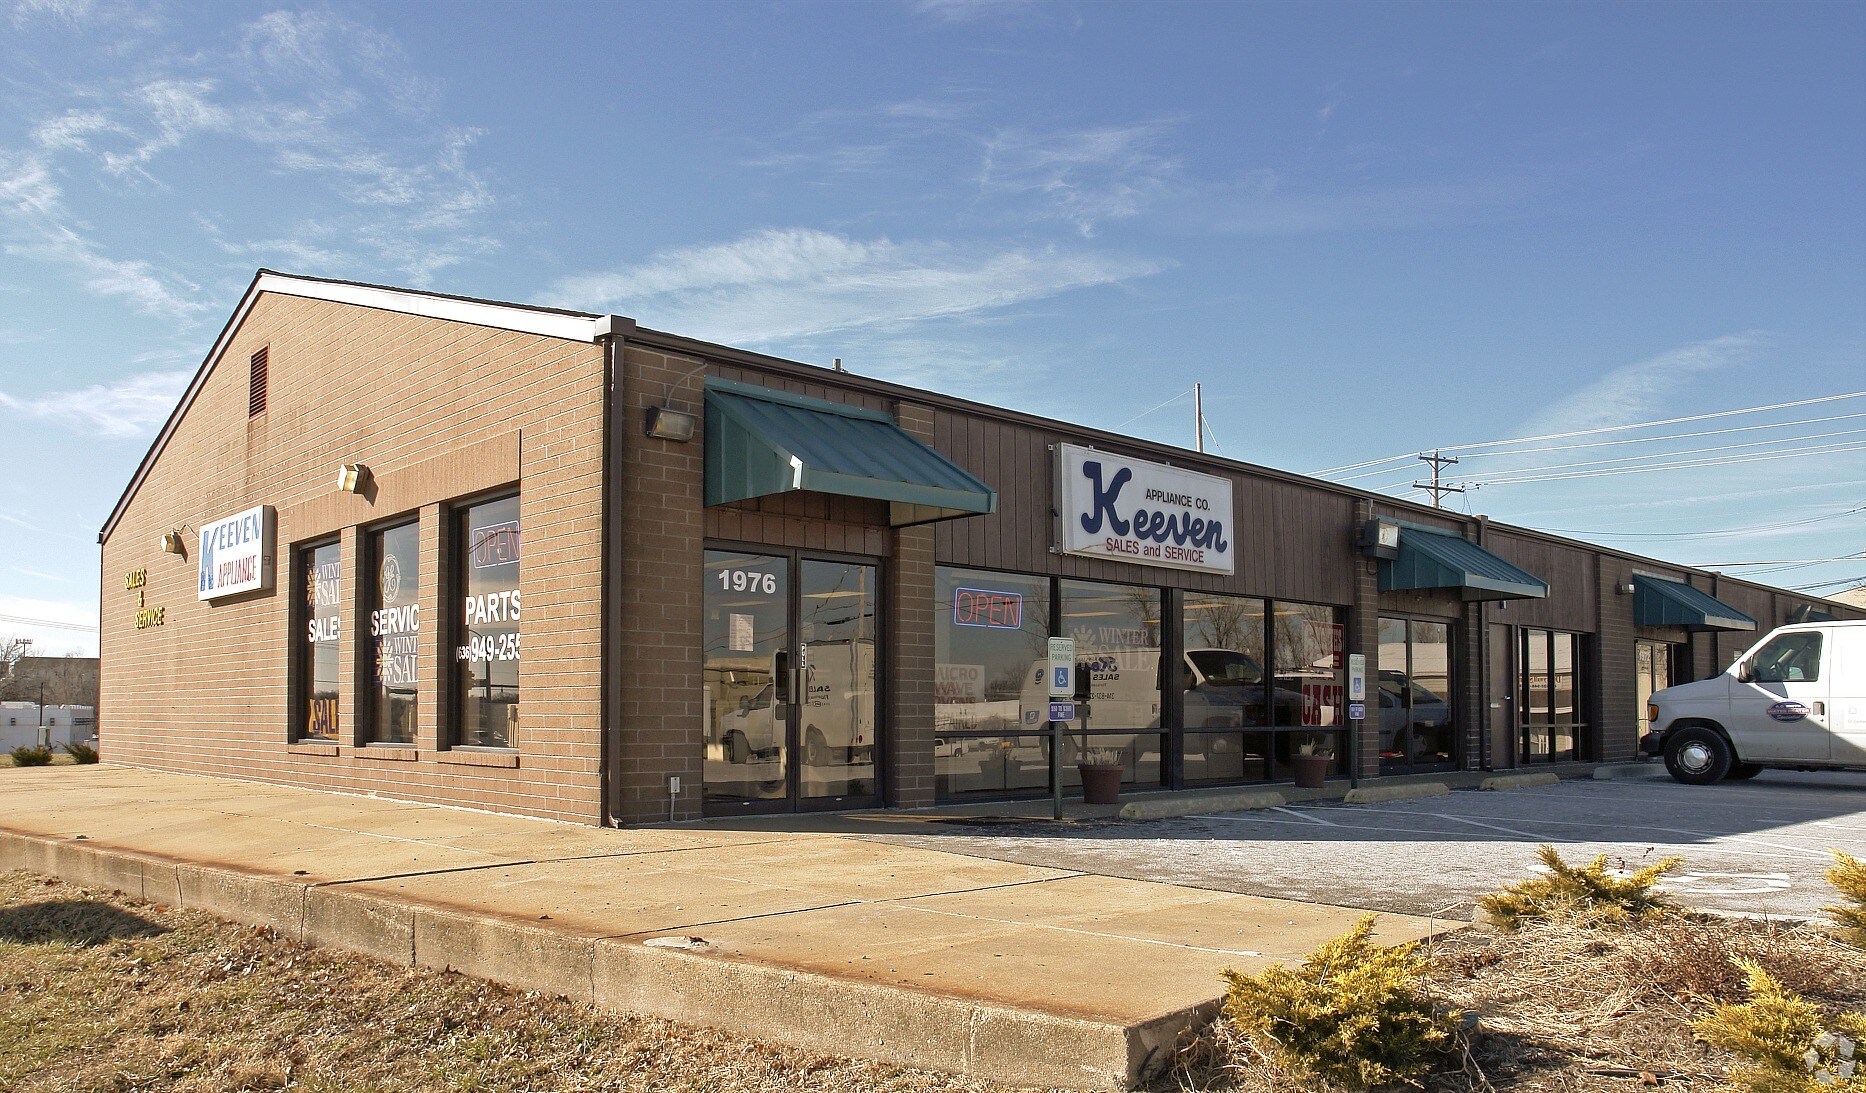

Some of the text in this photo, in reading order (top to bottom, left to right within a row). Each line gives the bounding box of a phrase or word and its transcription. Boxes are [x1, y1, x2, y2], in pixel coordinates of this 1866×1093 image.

[1081, 461, 1228, 553] Keeven
[1146, 488, 1211, 511] APPLIANCE CO.
[200, 512, 262, 592] KEEVEN
[475, 526, 519, 563] OPEN
[1106, 537, 1205, 563] SALES and SERVICE
[125, 568, 147, 590] SALES
[217, 555, 257, 589] APPLIANCE
[322, 562, 340, 580] WINT
[719, 570, 776, 594] 1976
[322, 579, 340, 606] SAL
[135, 607, 165, 629] SERVICE
[371, 604, 419, 636] SERVIC
[465, 590, 520, 625] PARTS
[957, 592, 1019, 626] OPEN
[394, 636, 418, 654] WINT
[1050, 643, 1073, 651] RESERVED
[1099, 627, 1149, 645] WINTER
[394, 655, 418, 684] SAL
[1051, 653, 1071, 661] PARKING
